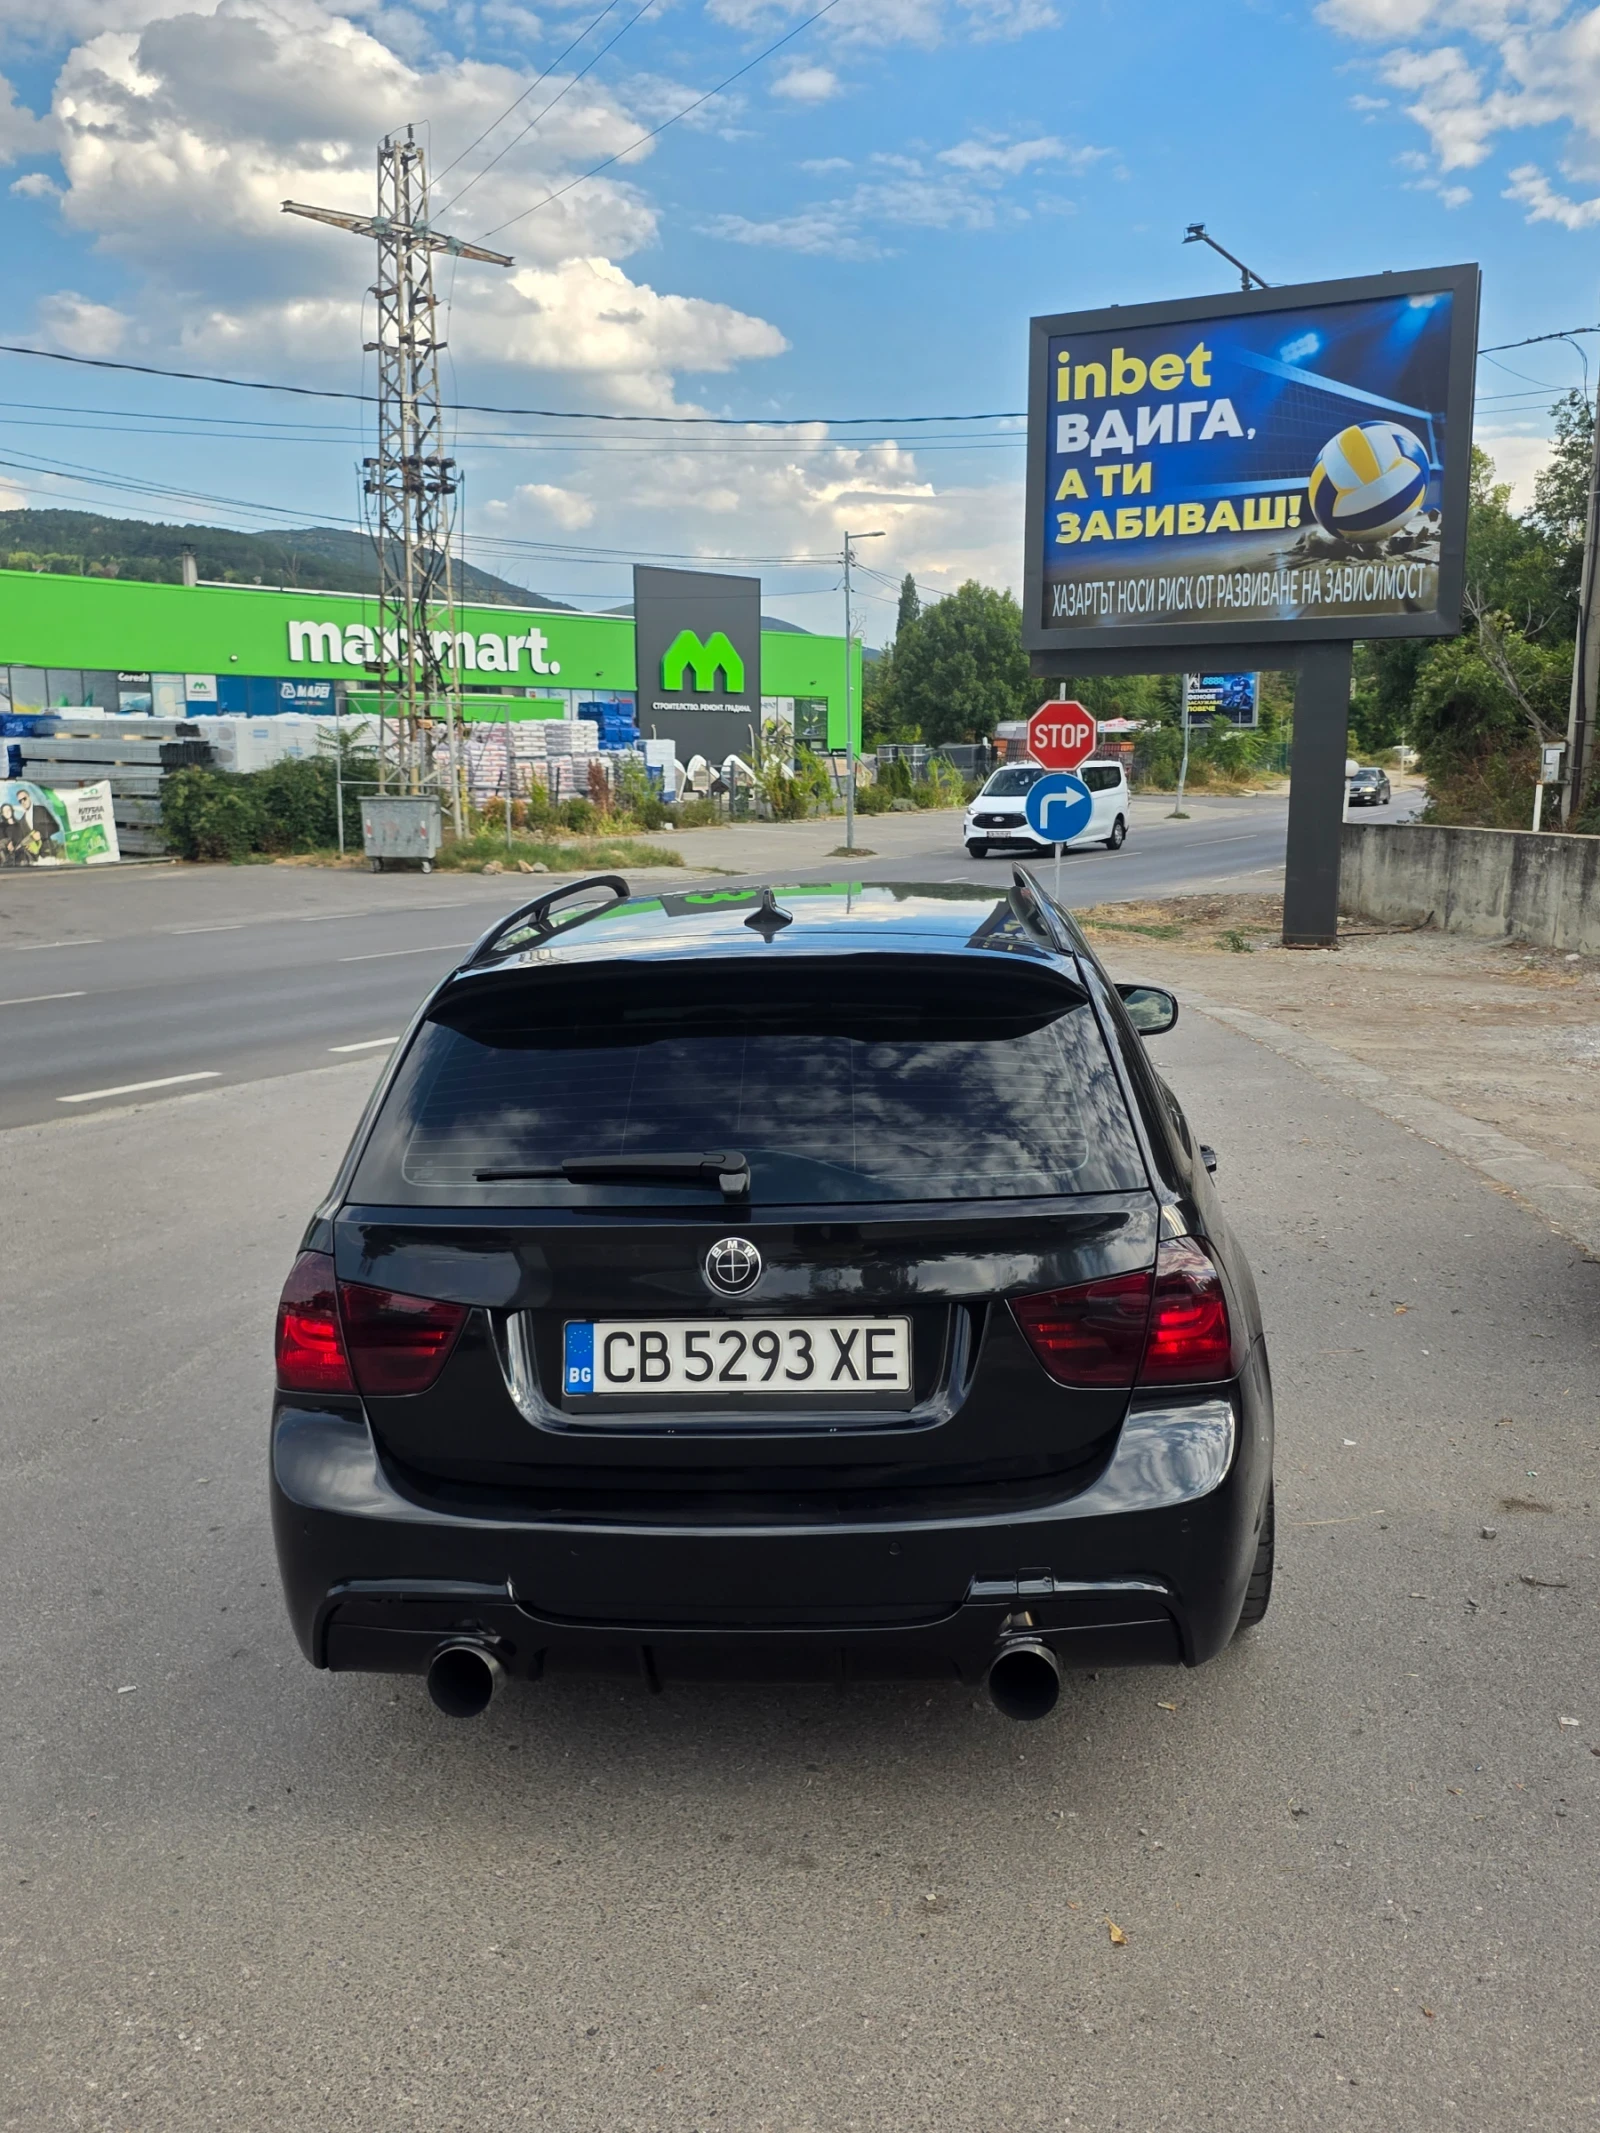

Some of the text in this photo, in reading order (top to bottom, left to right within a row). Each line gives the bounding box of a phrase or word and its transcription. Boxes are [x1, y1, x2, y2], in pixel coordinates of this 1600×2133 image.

[1057, 342, 1212, 402] inbet
[1056, 398, 1256, 457] ВДИГА,
[1055, 462, 1152, 500] А ТИ
[1056, 495, 1302, 543] ЗАБИВАШ!
[1052, 563, 1426, 617] ХАЗАРТЪТ НОСИ РИСК ОТ РАЗВИВАНЕ НА ЗАВИСИМОСТ
[297, 684, 331, 699] MAPEI
[1034, 723, 1090, 749] STOP
[711, 1240, 756, 1259] BMW
[569, 1328, 898, 1383] BG CB 5293 XE
